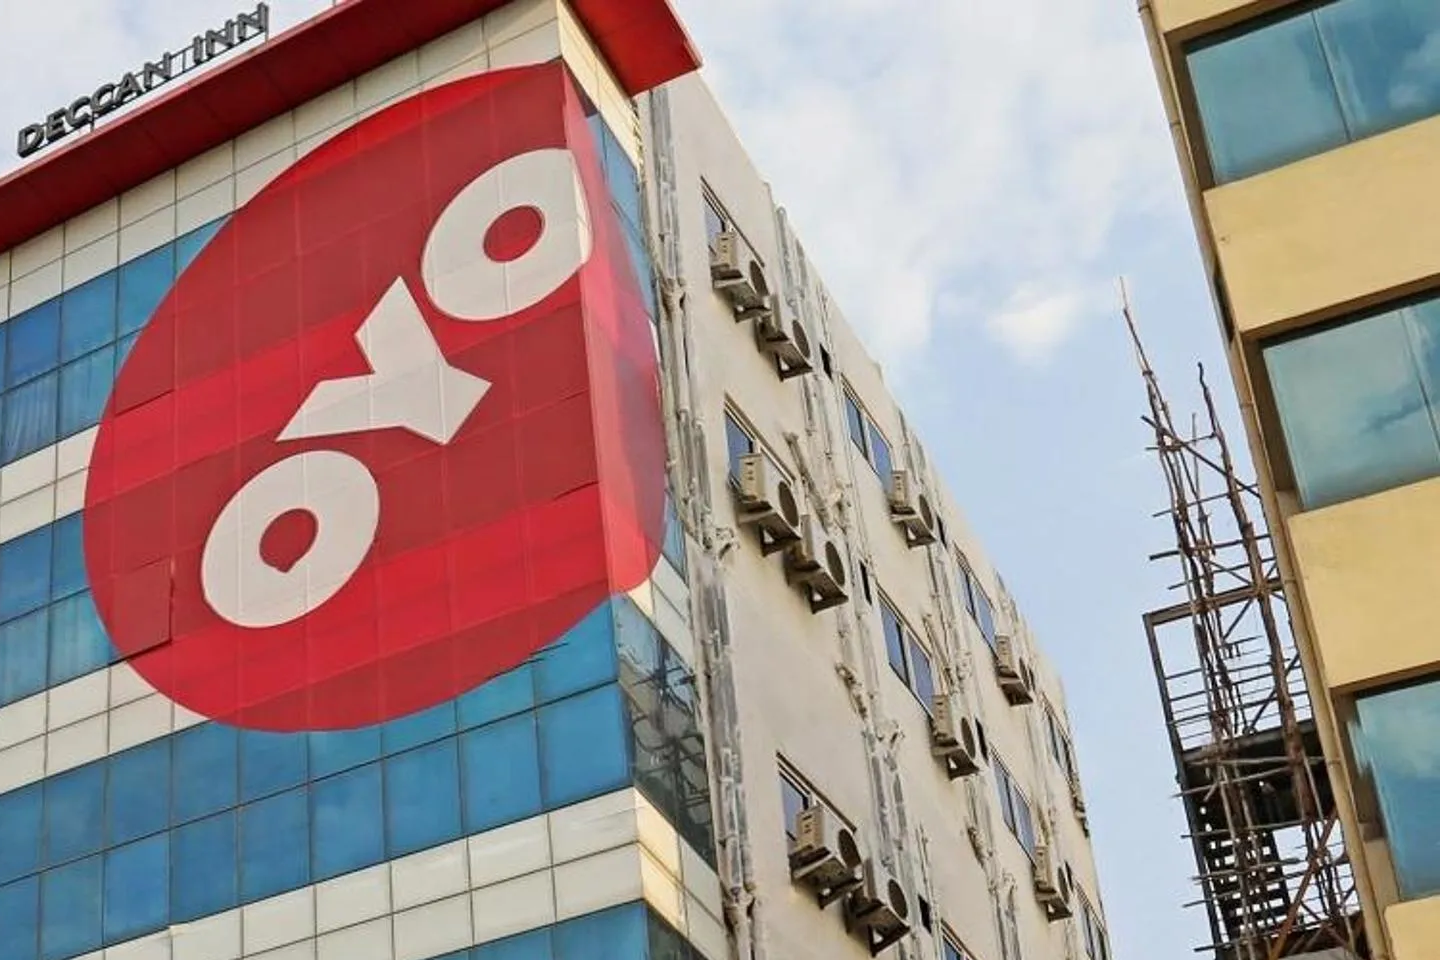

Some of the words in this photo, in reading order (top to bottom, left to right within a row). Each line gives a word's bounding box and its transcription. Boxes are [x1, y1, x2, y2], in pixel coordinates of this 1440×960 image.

[17, 51, 171, 158] DECCAN
[193, 3, 269, 65] INN
[201, 148, 593, 628] OYO
